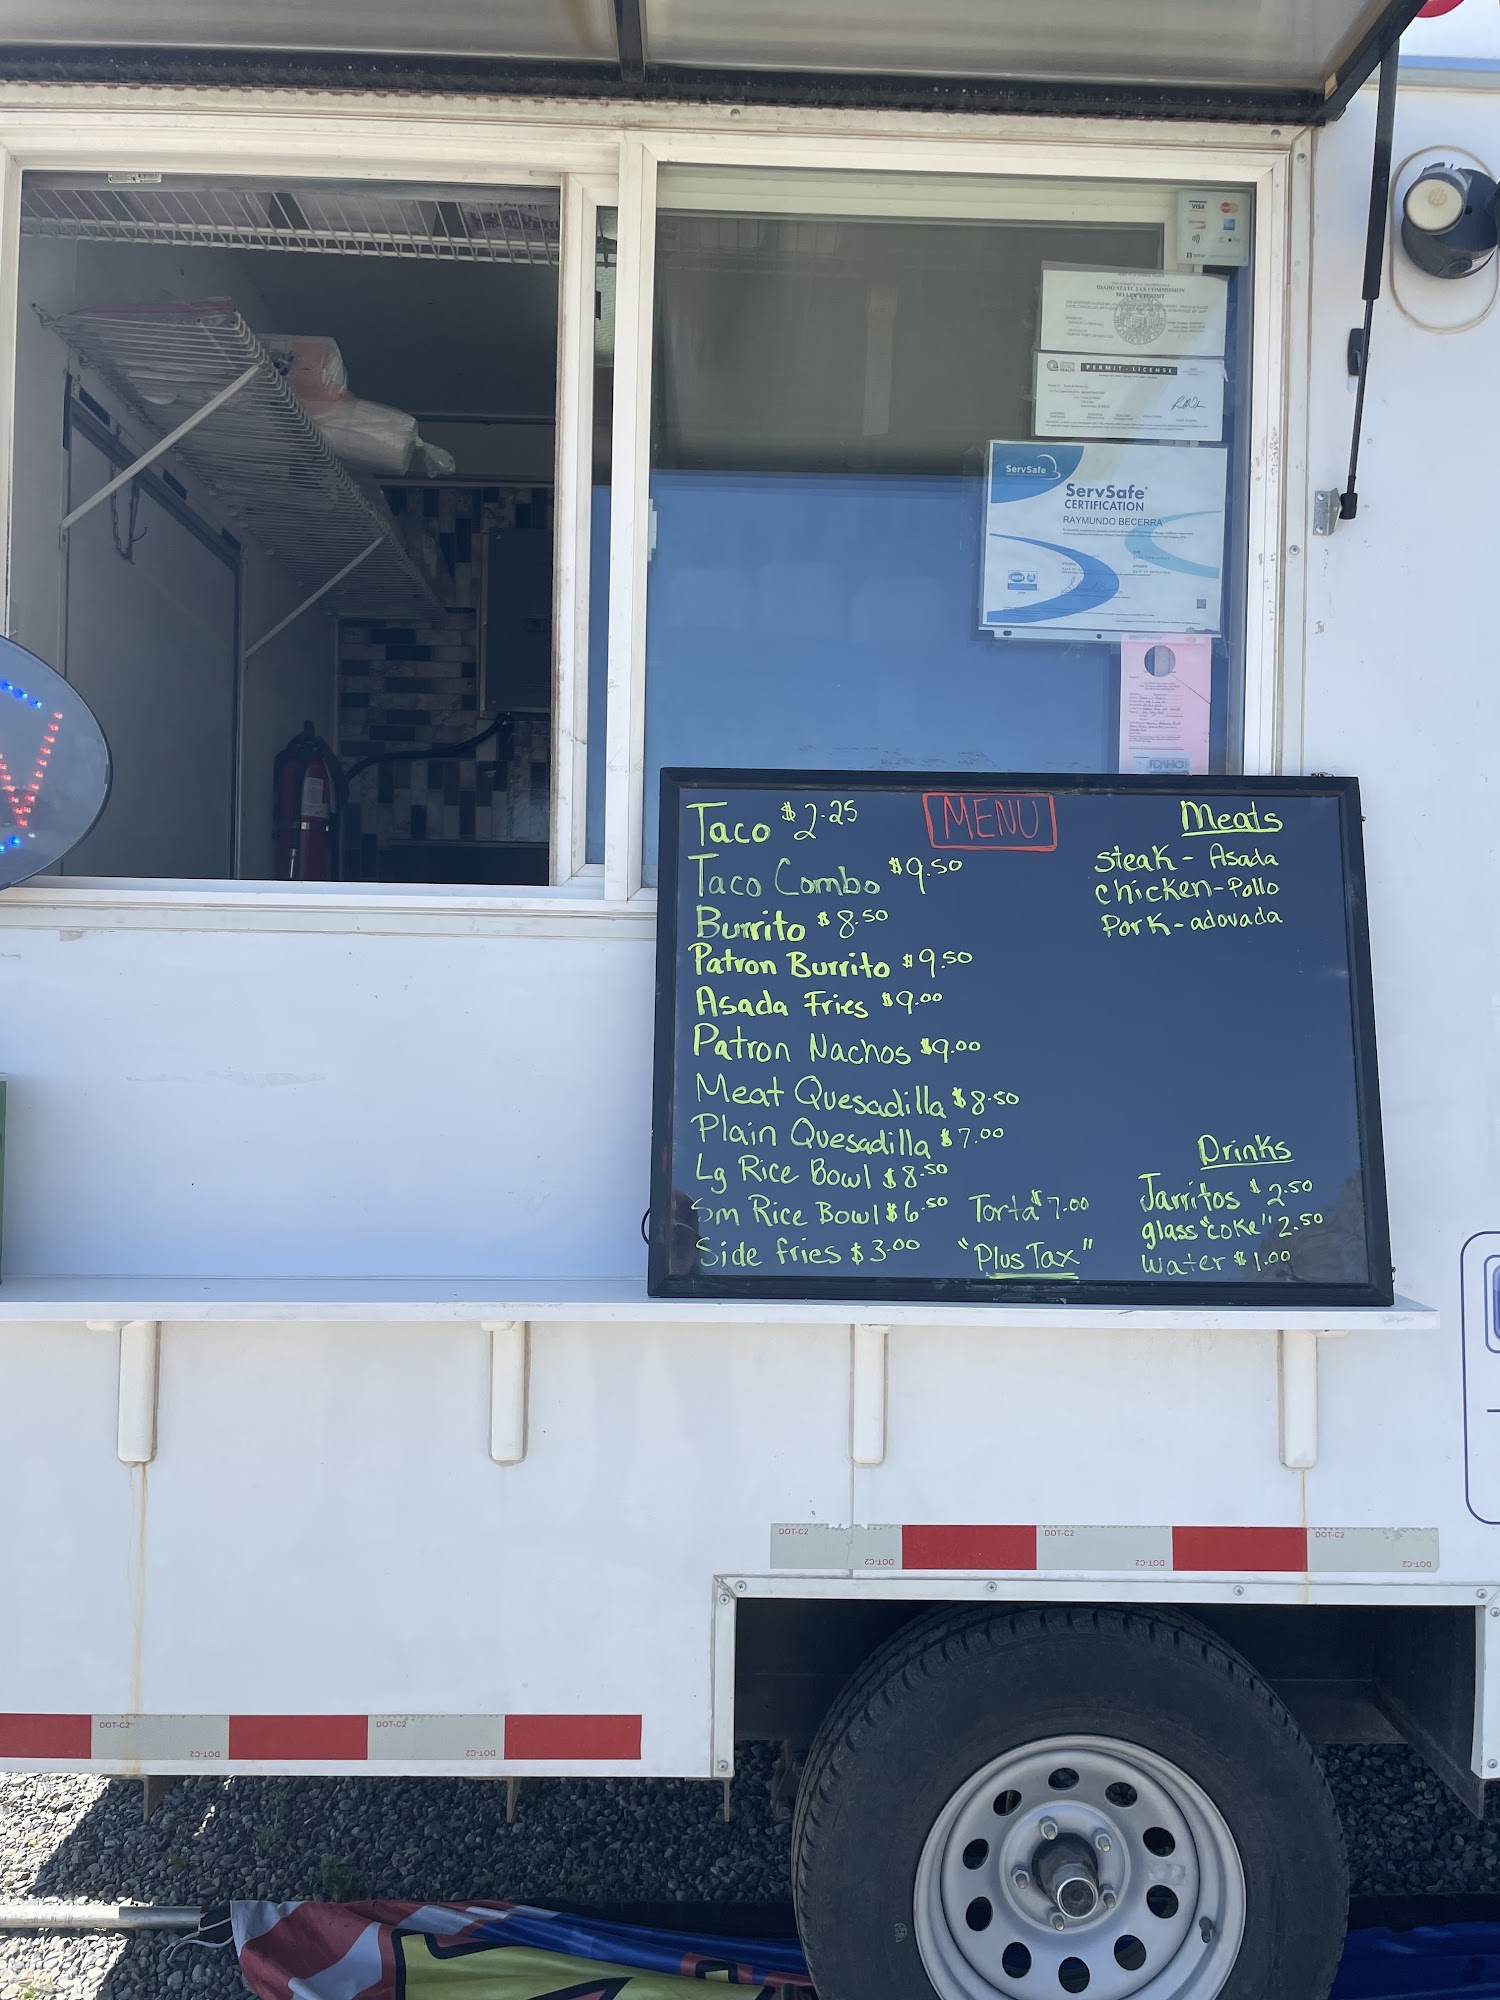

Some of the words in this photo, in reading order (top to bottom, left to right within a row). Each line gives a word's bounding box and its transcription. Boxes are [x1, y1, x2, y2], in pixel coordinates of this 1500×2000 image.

[1086, 364, 1122, 372] PERMIT
[1132, 366, 1173, 374] LICENSE
[1006, 464, 1046, 474] ServSafe
[1064, 499, 1144, 512] CERTIFICATION
[1066, 482, 1146, 500] ServSafe
[1062, 516, 1116, 526] RAYMUNDO
[1118, 518, 1163, 527] BECERRA
[686, 801, 771, 846] Taco
[780, 800, 859, 841] $2.25
[942, 795, 1040, 841] MENU
[1180, 800, 1284, 832] Meats
[1209, 843, 1280, 870] Asada
[687, 853, 762, 897] Taco
[774, 857, 881, 897] Combo
[888, 856, 963, 895] $9.50
[696, 904, 806, 942] Burrito
[817, 909, 888, 939] $8.50
[687, 942, 778, 976] Patron
[786, 951, 891, 979] Burrito
[902, 948, 974, 979] $9.50
[696, 985, 789, 1018] Asada
[803, 990, 870, 1019] Fries
[881, 990, 943, 1015] $9.00
[693, 1022, 791, 1063] Patron
[809, 1032, 912, 1065] Nachos
[920, 1036, 981, 1063] $9.00
[696, 1072, 784, 1107] Meat
[794, 1075, 948, 1119] Quesadilla
[951, 1086, 1020, 1116] $8.50
[690, 1112, 778, 1147] Plain
[790, 1117, 932, 1159] Quesadilla
[940, 1127, 1004, 1149] $7.00
[1196, 1134, 1293, 1167] Drinks
[696, 1152, 727, 1195] Lg
[738, 1154, 799, 1184] Rice
[810, 1158, 872, 1189] Bowl
[882, 1162, 948, 1189] $8.50
[968, 1193, 1040, 1224] Torta
[1137, 1172, 1241, 1213] Jarritos
[1249, 1178, 1314, 1208] $2.50
[690, 1198, 740, 1226] Sm
[748, 1194, 808, 1226] Rice
[814, 1200, 879, 1225] Bowl
[886, 1196, 949, 1224] $6.50
[1140, 1219, 1199, 1251] glass
[1277, 1212, 1324, 1239] 2.50
[694, 1236, 762, 1268] Side
[775, 1236, 842, 1264] fries
[850, 1238, 920, 1266] $3.00
[1233, 1250, 1292, 1272] $1.00
[778, 1528, 809, 1536] DOT-C2
[376, 1721, 407, 1729] DOT-C2
